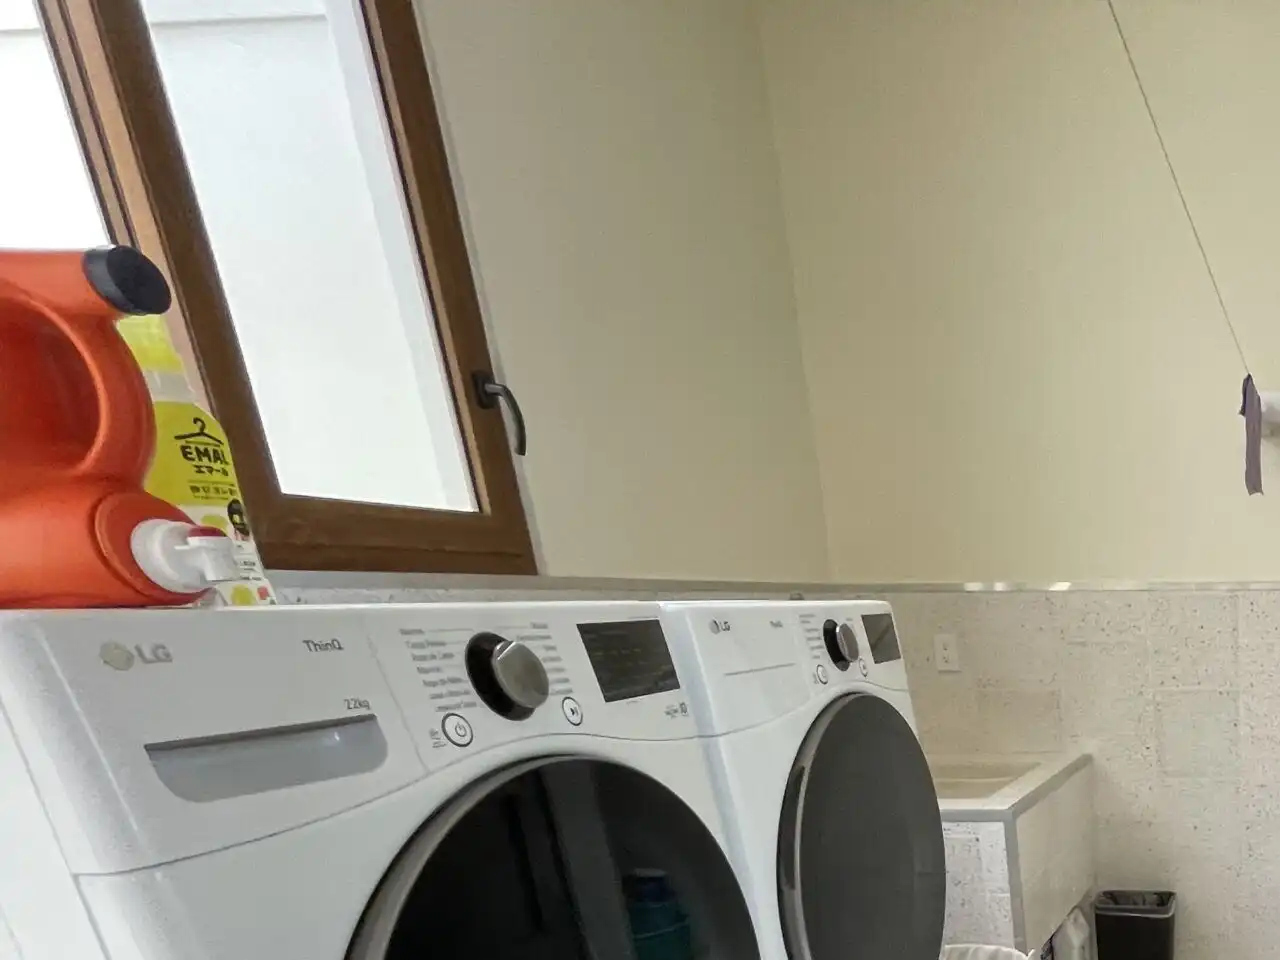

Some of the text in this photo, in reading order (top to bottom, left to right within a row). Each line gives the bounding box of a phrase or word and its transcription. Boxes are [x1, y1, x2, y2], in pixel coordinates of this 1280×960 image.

[180, 445, 229, 465] EMAL
[134, 644, 173, 664] LG
[302, 639, 344, 652] ThinQ
